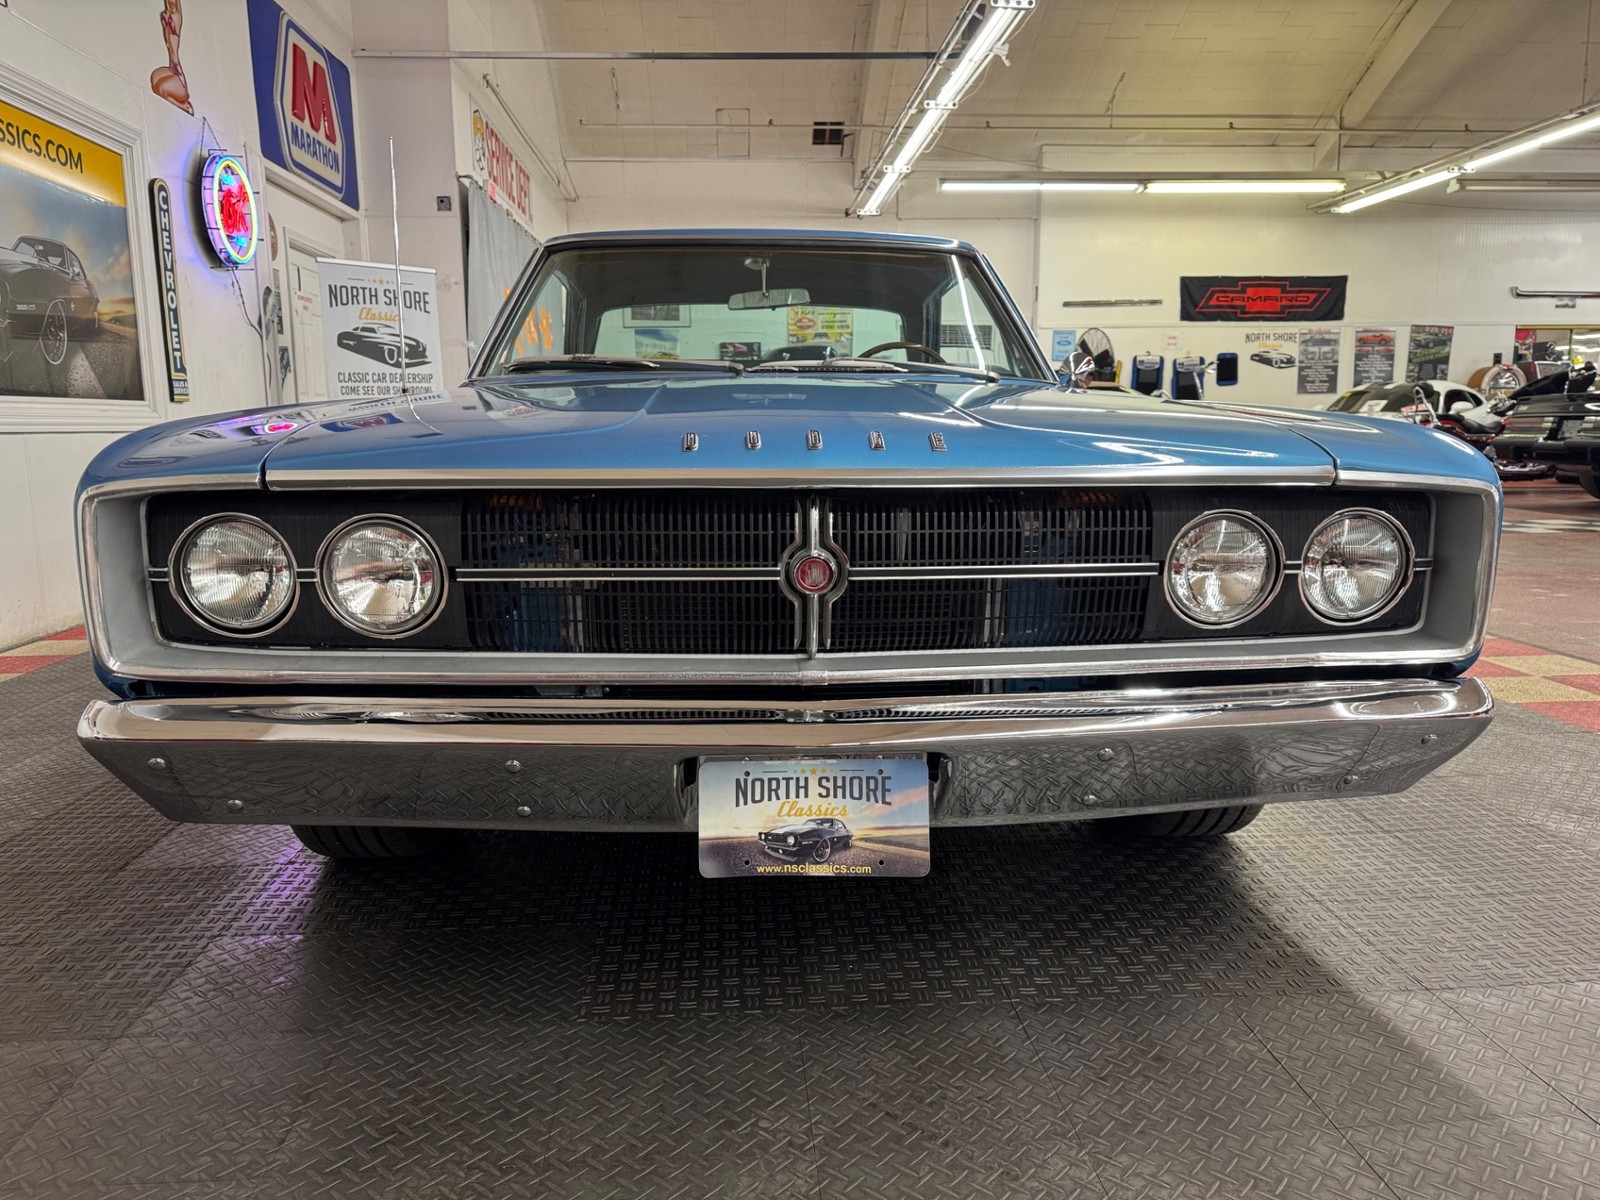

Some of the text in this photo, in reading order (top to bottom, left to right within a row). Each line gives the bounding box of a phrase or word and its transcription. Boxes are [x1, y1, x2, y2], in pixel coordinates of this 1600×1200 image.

[291, 42, 337, 146] M
[290, 121, 341, 175] MARATHON
[485, 120, 516, 205] SERVICE
[159, 190, 182, 369] CHEVROLET
[327, 284, 379, 308] NORTH
[1215, 295, 1311, 303] CAMARO
[357, 306, 405, 323] Classic
[1245, 332, 1298, 344] NORTH SHORE
[337, 371, 434, 384] CLASSIC CAR DEAERSHIP
[340, 385, 432, 396] COME SEE OUR SHROOM!
[682, 429, 948, 452] DODGE
[735, 775, 892, 808] NORTH SHORE
[776, 799, 849, 818] Classics
[756, 862, 872, 874] www.nsclassics.com
